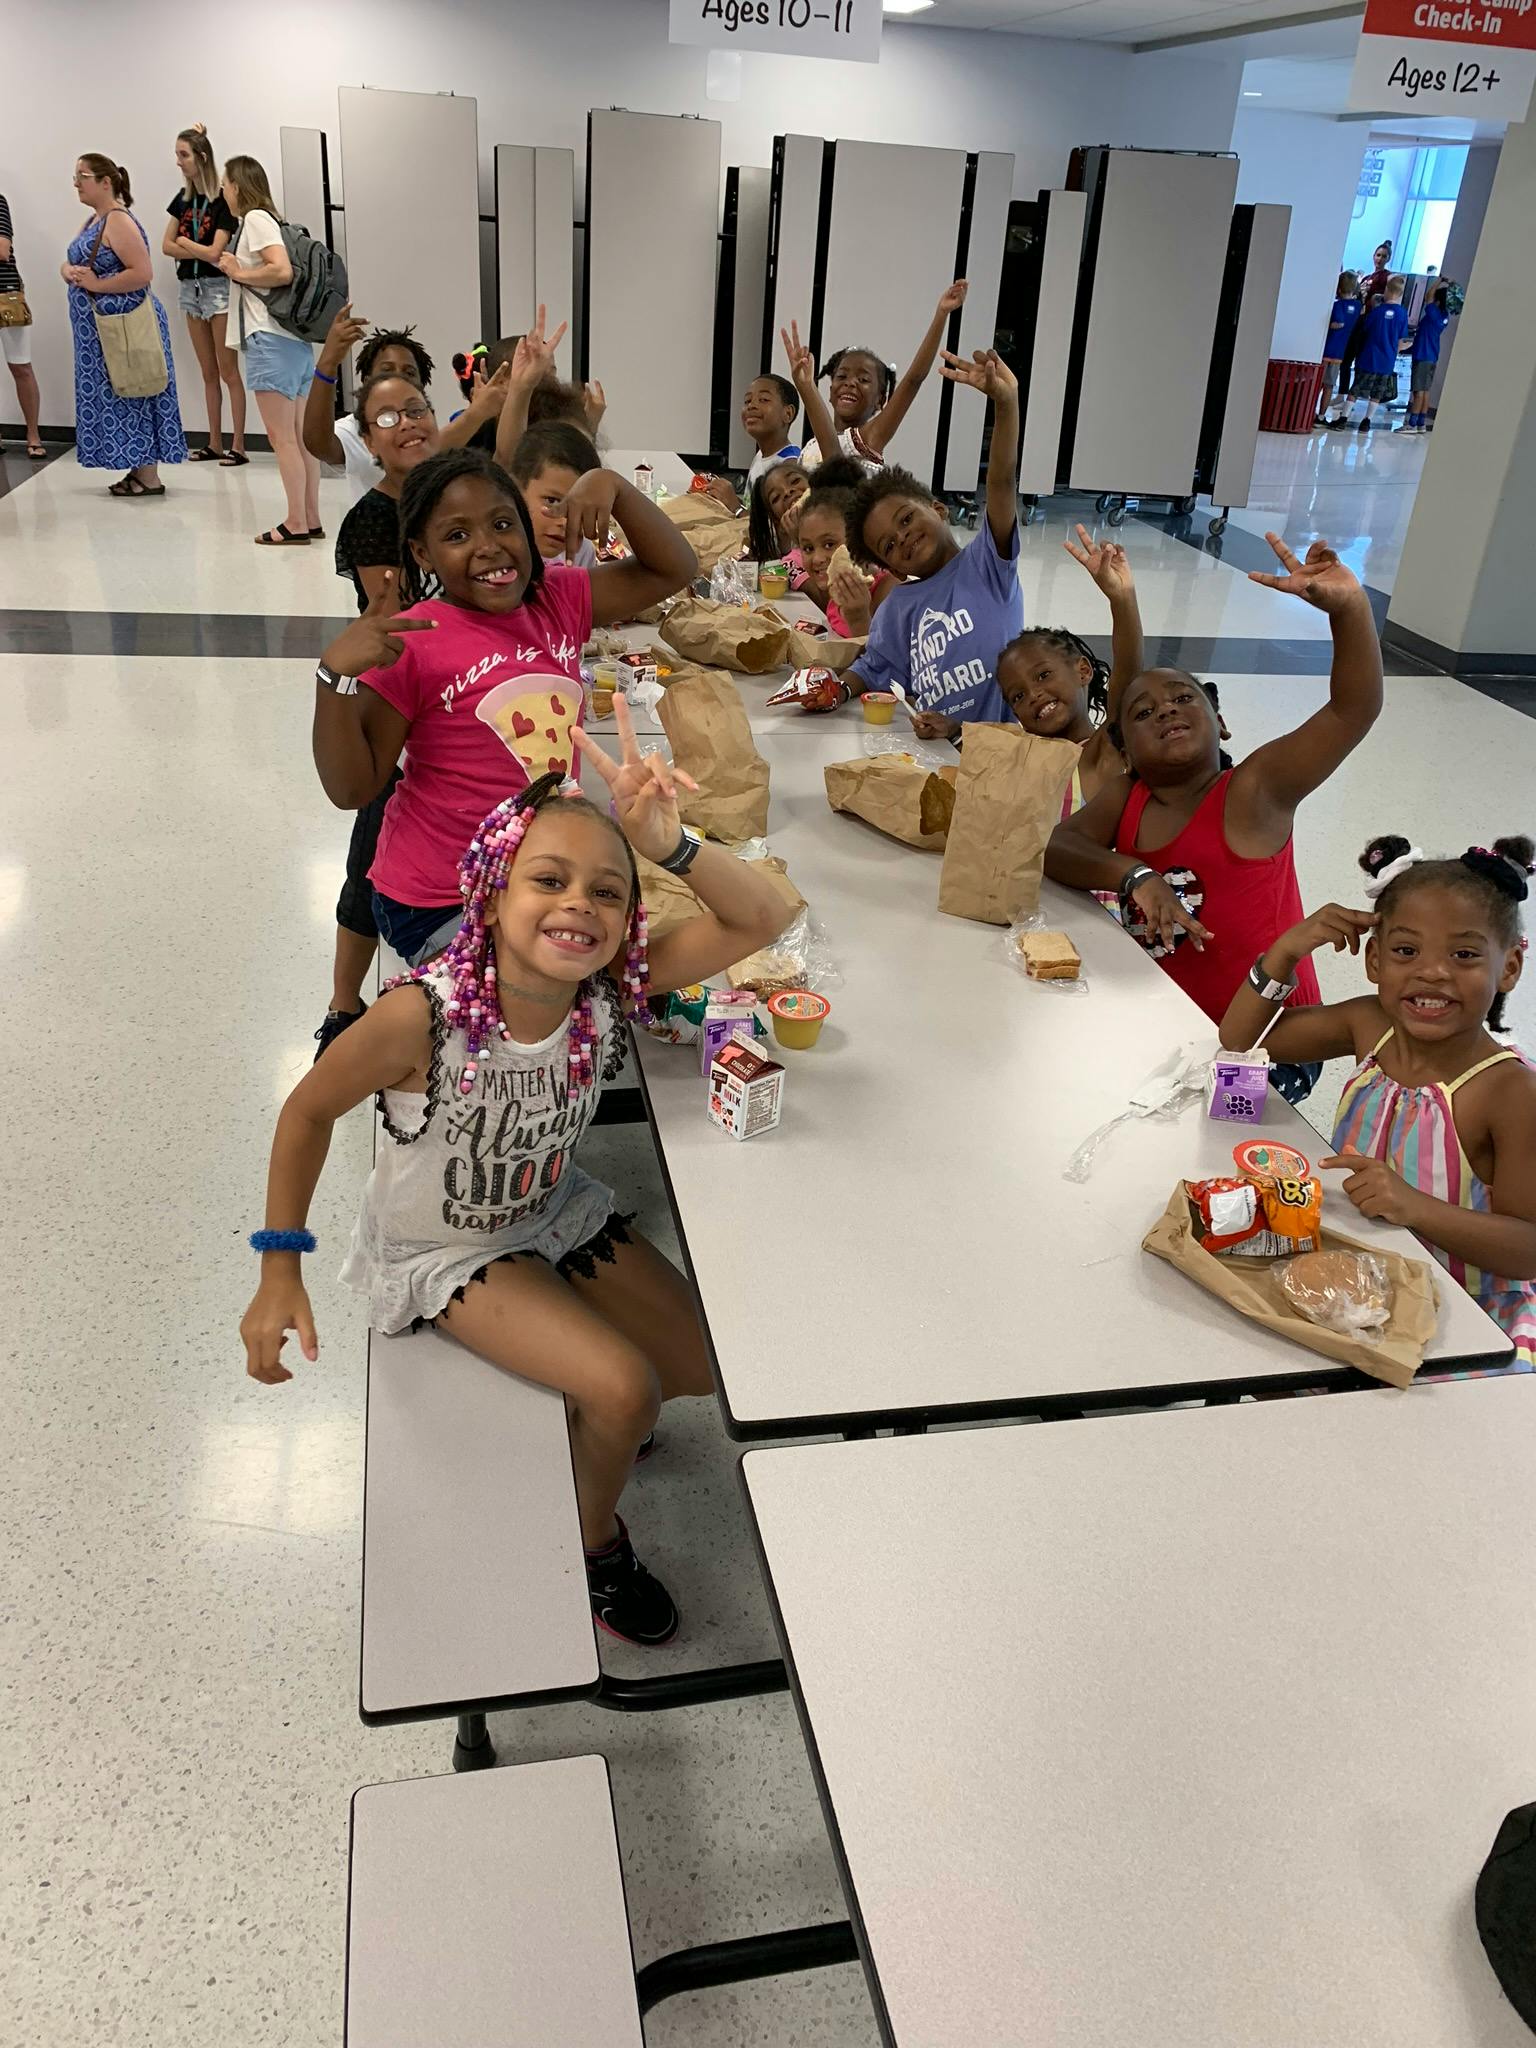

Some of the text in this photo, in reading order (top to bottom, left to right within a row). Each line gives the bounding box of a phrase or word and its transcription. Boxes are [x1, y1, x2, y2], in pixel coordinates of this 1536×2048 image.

[702, 0, 769, 31] Ages
[1414, 4, 1502, 34] Check-In
[1480, 0, 1532, 16] mp
[1388, 57, 1500, 98] Ages 12+
[516, 644, 544, 662] is
[482, 1067, 546, 1101] MATTER
[724, 1088, 741, 1108] MILK
[445, 1100, 587, 1161] Alway
[444, 1149, 565, 1206] CHOO
